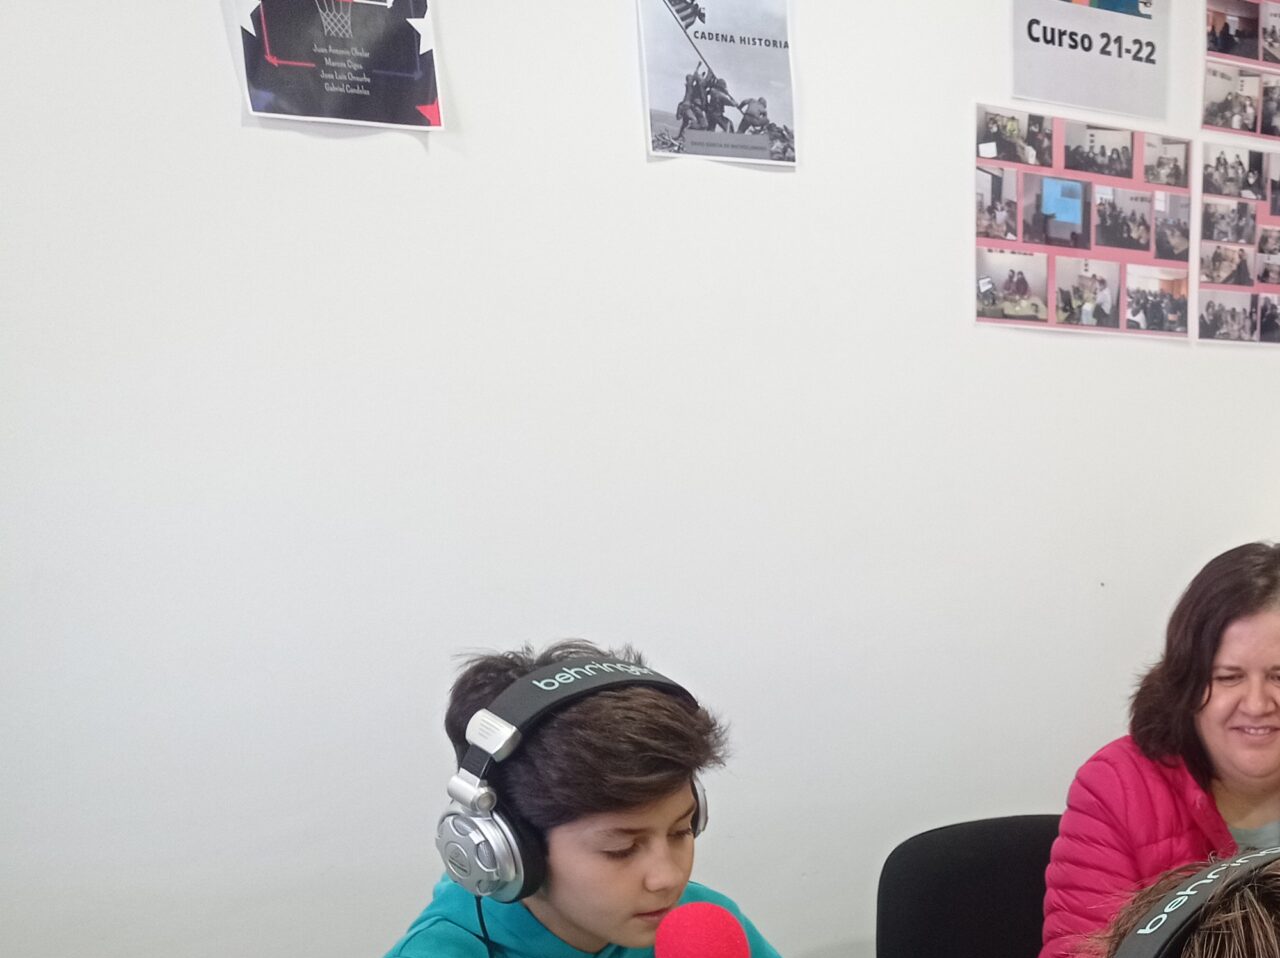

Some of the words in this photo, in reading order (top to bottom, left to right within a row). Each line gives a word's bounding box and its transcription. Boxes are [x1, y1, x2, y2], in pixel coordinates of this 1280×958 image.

[693, 30, 736, 44] CADENA
[739, 35, 790, 49] HISTORIA
[1026, 18, 1093, 53] Curso
[1099, 32, 1157, 65] 21-22
